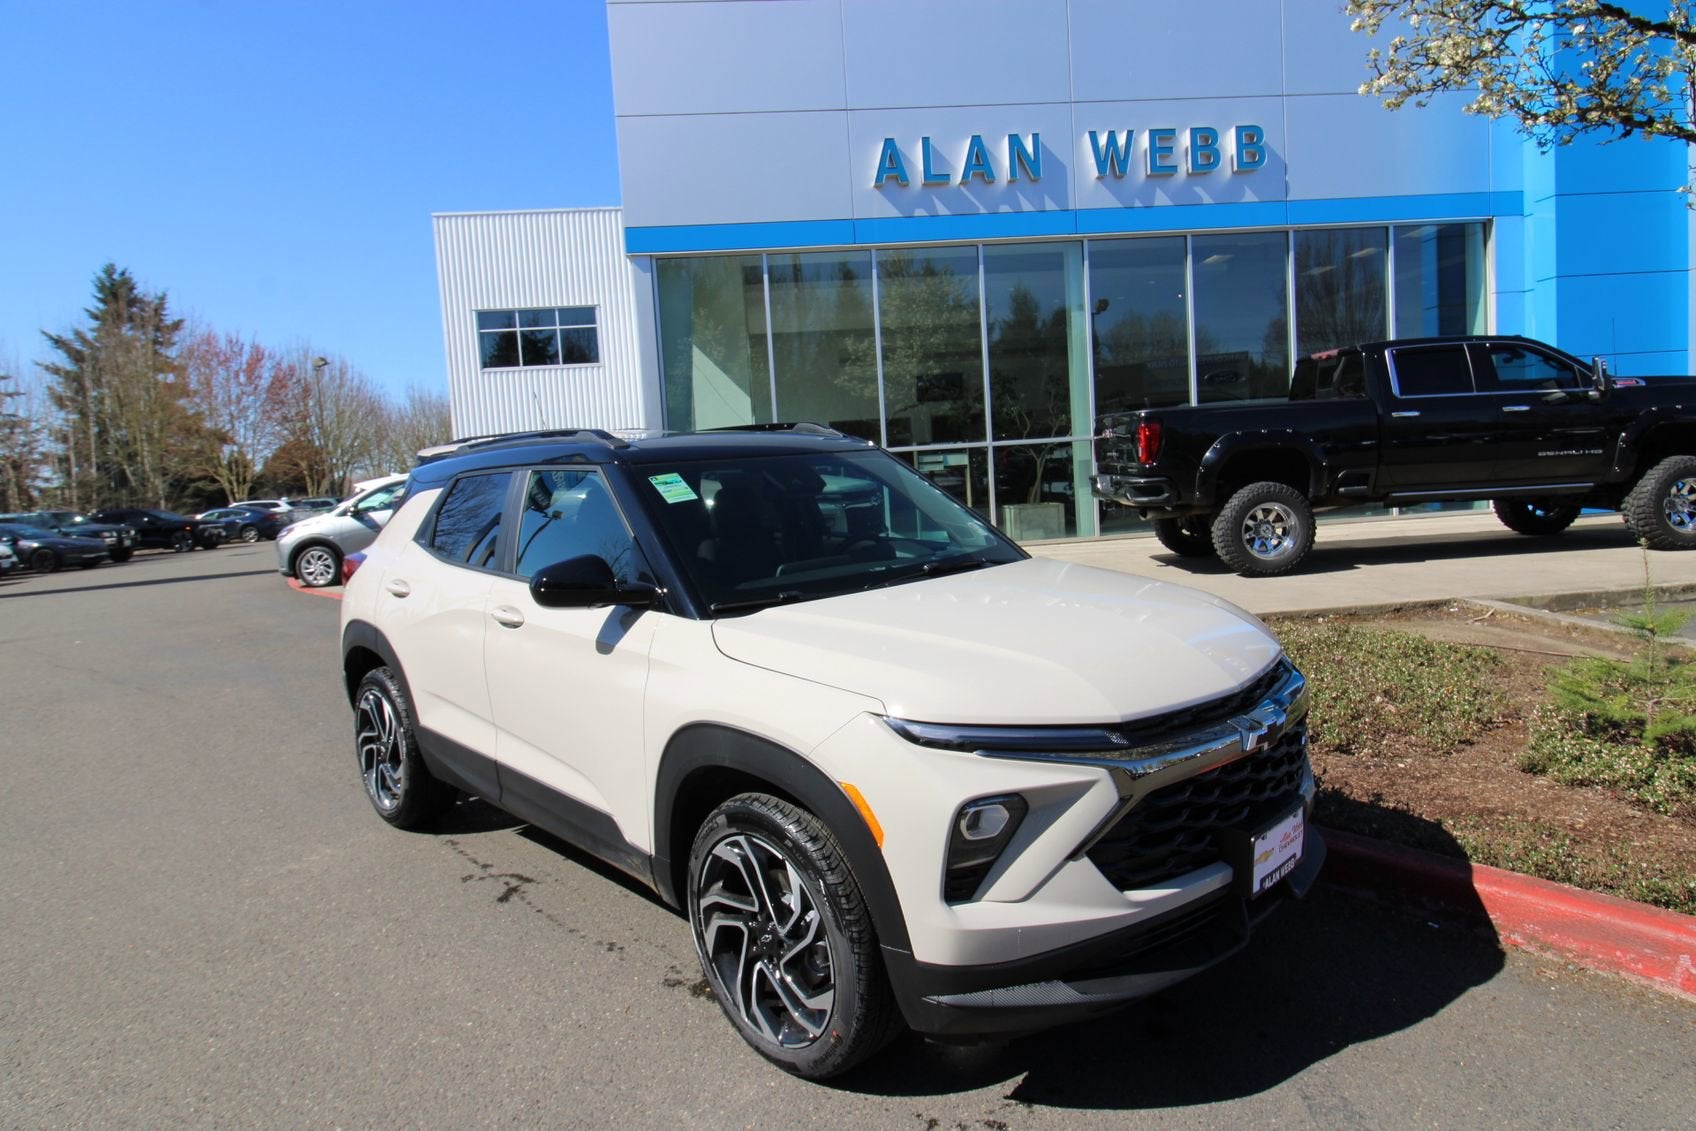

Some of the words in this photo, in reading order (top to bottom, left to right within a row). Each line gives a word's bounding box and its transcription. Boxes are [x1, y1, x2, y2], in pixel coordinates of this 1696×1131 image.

[873, 132, 1044, 187] ALAN
[1088, 124, 1268, 180] WEBB
[1264, 868, 1280, 890] ALAN
